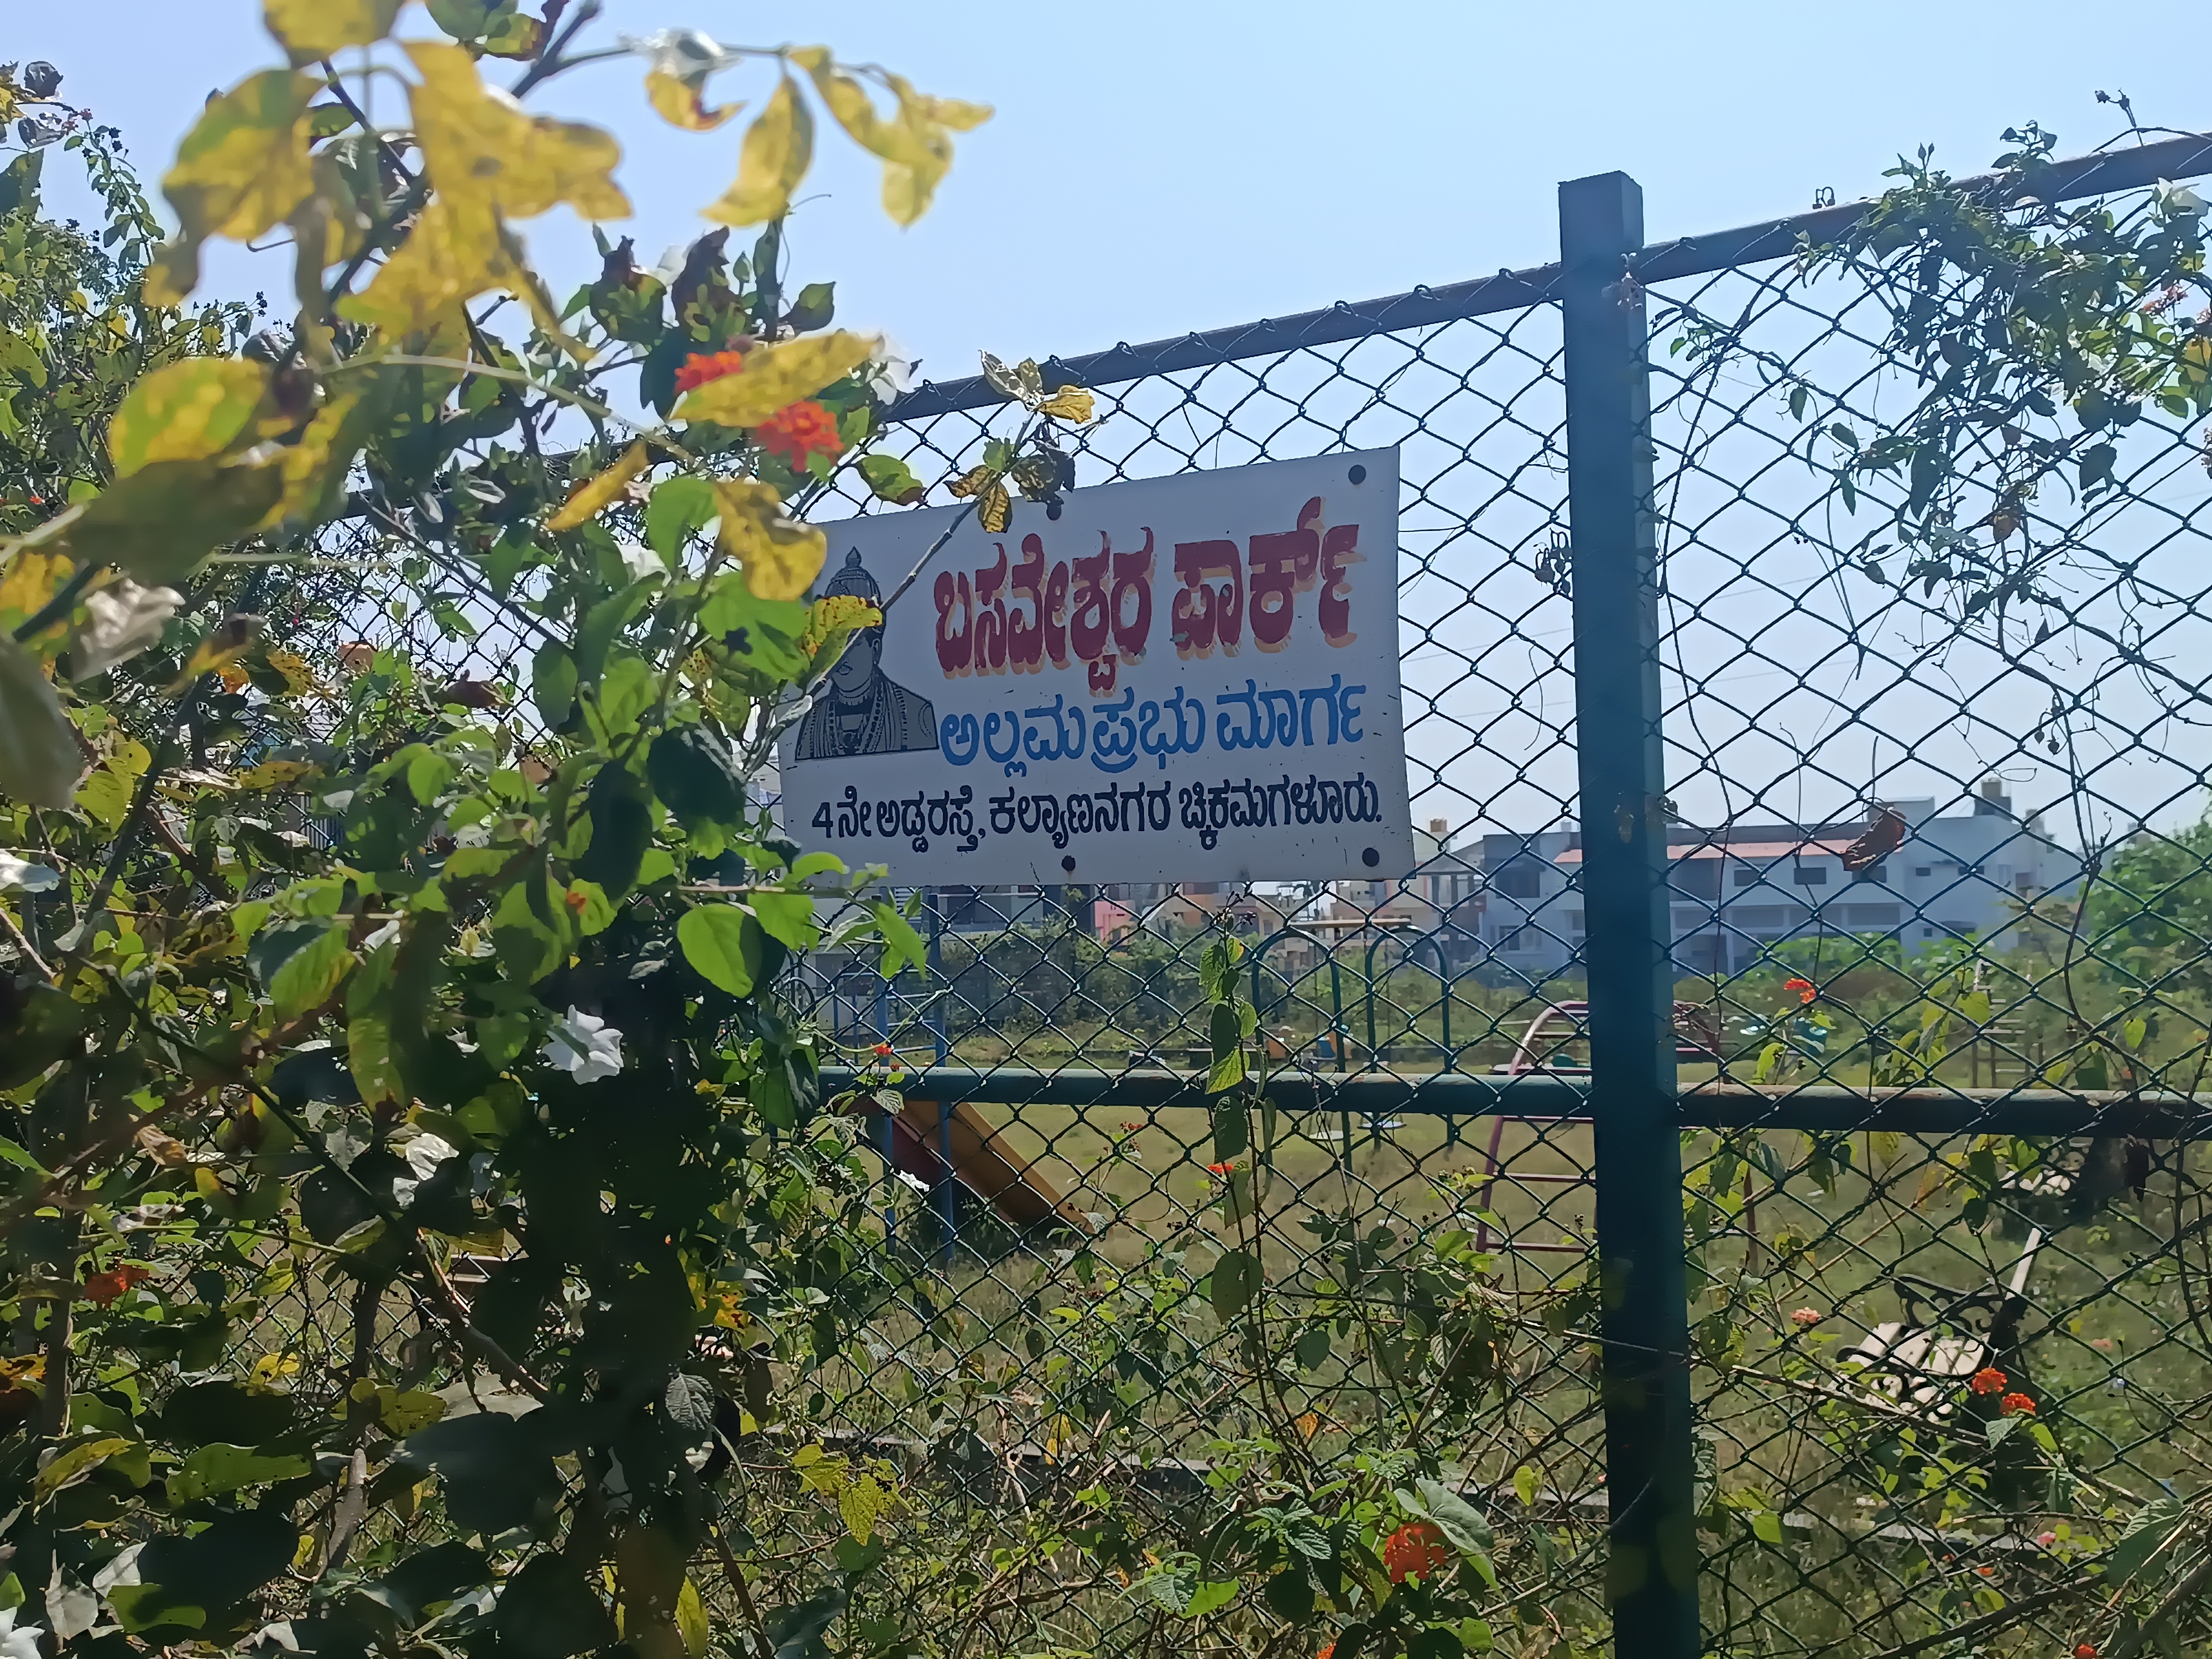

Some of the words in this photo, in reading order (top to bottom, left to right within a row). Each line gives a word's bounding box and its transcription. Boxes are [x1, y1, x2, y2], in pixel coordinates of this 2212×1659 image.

[933, 528, 1157, 698] ಬಸವೇಶ್ವರ
[1170, 497, 1366, 661] ಪಾರ್ಕ್
[1217, 674, 1366, 751] ಮಾರ್ಗ
[989, 780, 1171, 849] ಕಲ್ಯಾಣನಗರ
